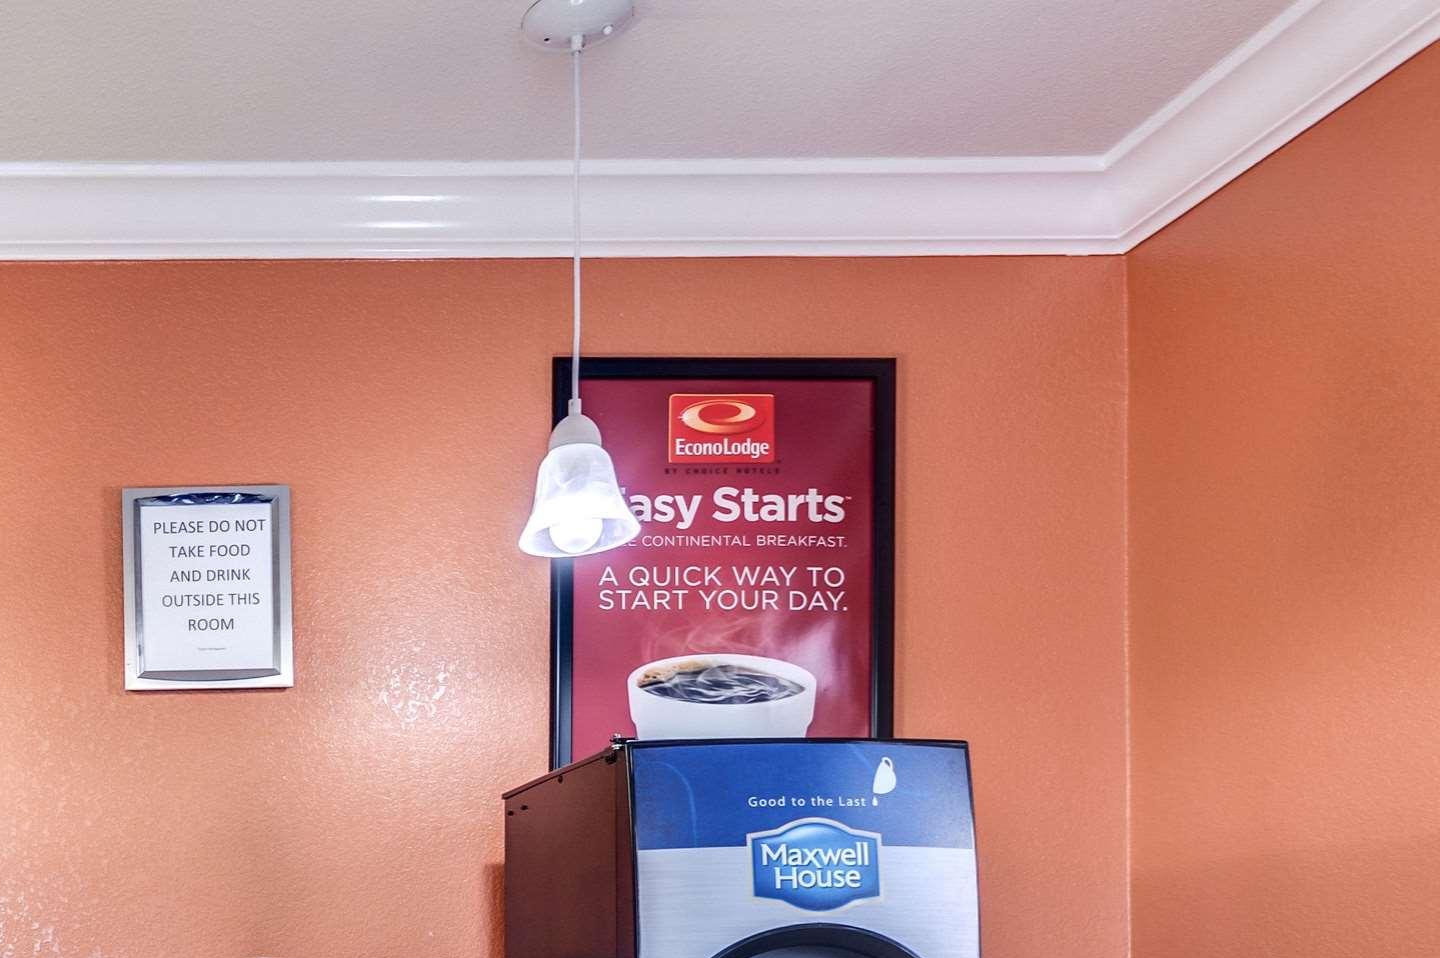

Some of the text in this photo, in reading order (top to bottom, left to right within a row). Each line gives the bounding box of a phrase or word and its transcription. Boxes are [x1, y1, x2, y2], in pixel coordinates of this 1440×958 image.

[675, 438, 769, 458] EconoLodge
[686, 467, 728, 475] CHOICE
[736, 467, 780, 475] HOTELS
[622, 486, 846, 530] asy Starts
[153, 519, 266, 534] PLEASE DO NOT
[642, 535, 750, 547] CONTINENTAL
[757, 535, 847, 548] BREAKFAST.
[169, 544, 250, 558] TAKE FOOD
[170, 569, 250, 582] AND DRINK
[598, 566, 845, 588] A QUICK WAY TO
[162, 592, 260, 607] OUTSIDE THIS
[598, 590, 848, 611] START YOUR DAY.
[188, 618, 234, 631] ROOM
[748, 796, 866, 807] Good to the Last
[760, 842, 869, 868] Maxwell
[775, 867, 862, 889] House
